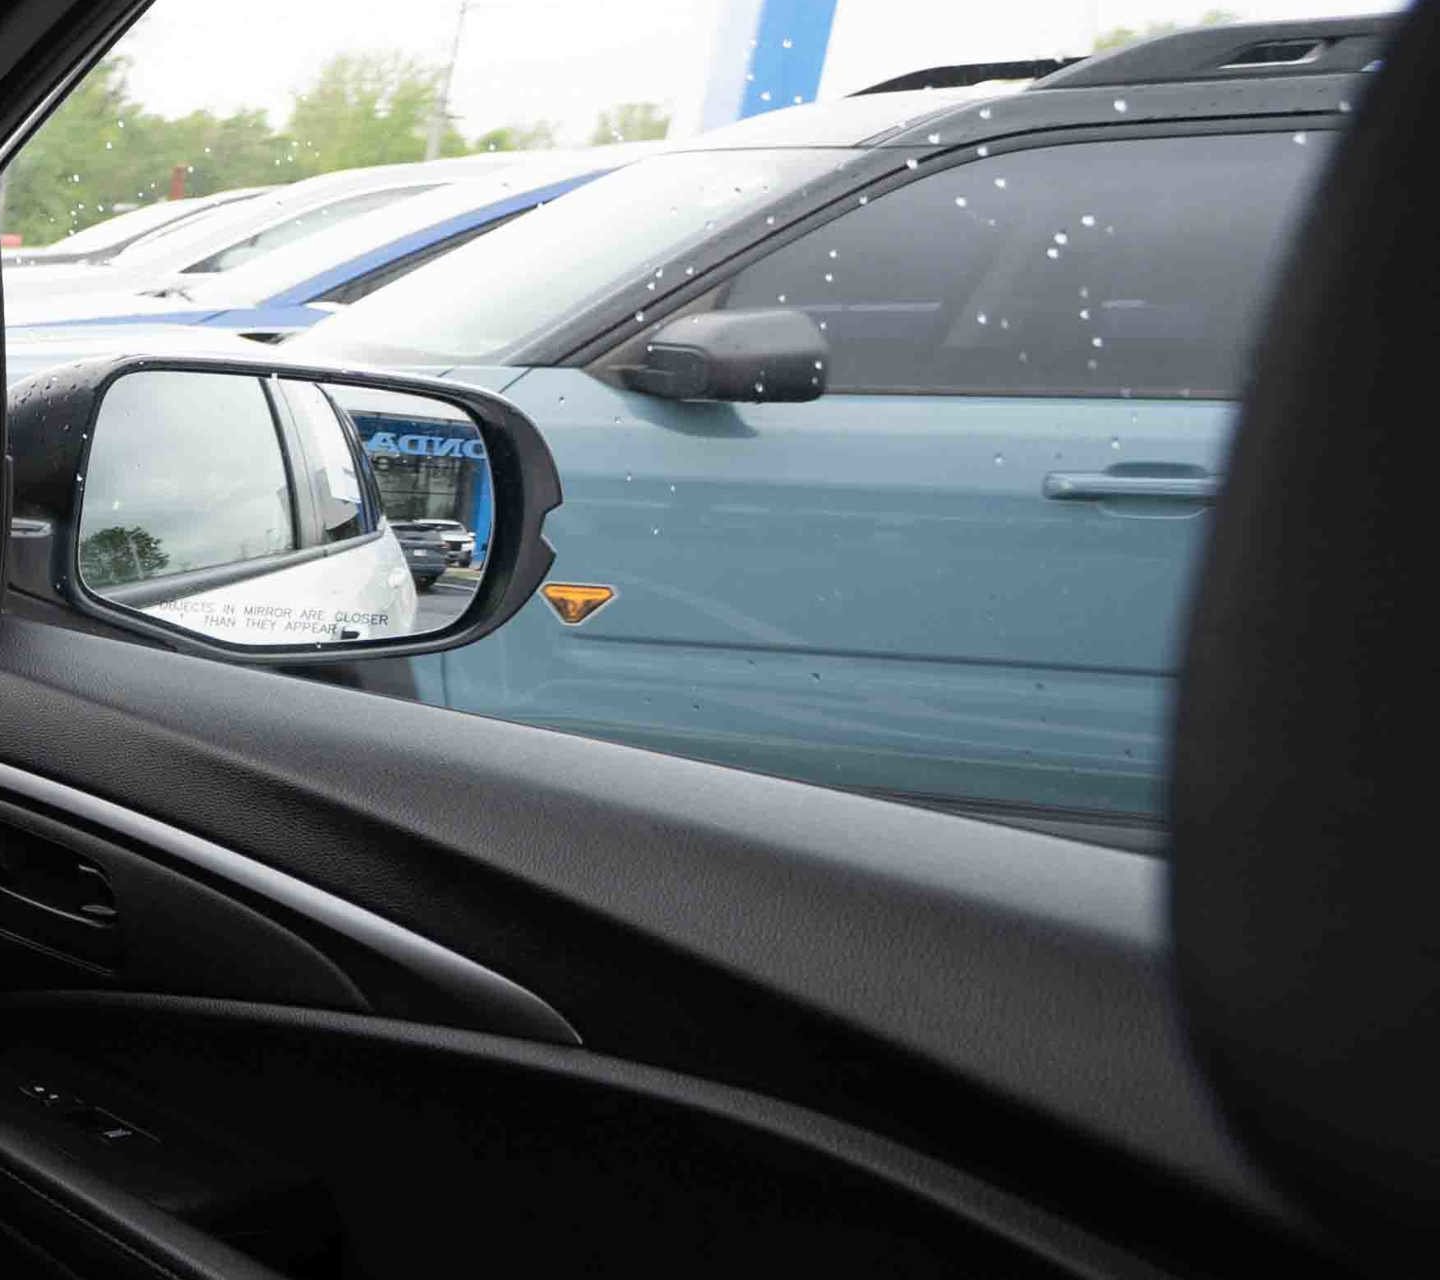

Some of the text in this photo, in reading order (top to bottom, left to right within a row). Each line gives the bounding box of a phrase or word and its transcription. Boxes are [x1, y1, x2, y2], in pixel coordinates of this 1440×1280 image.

[160, 601, 389, 625] OBJECTS IN MIRROR ARE CLOSER
[203, 616, 336, 634] THAN THEY APPEAR
